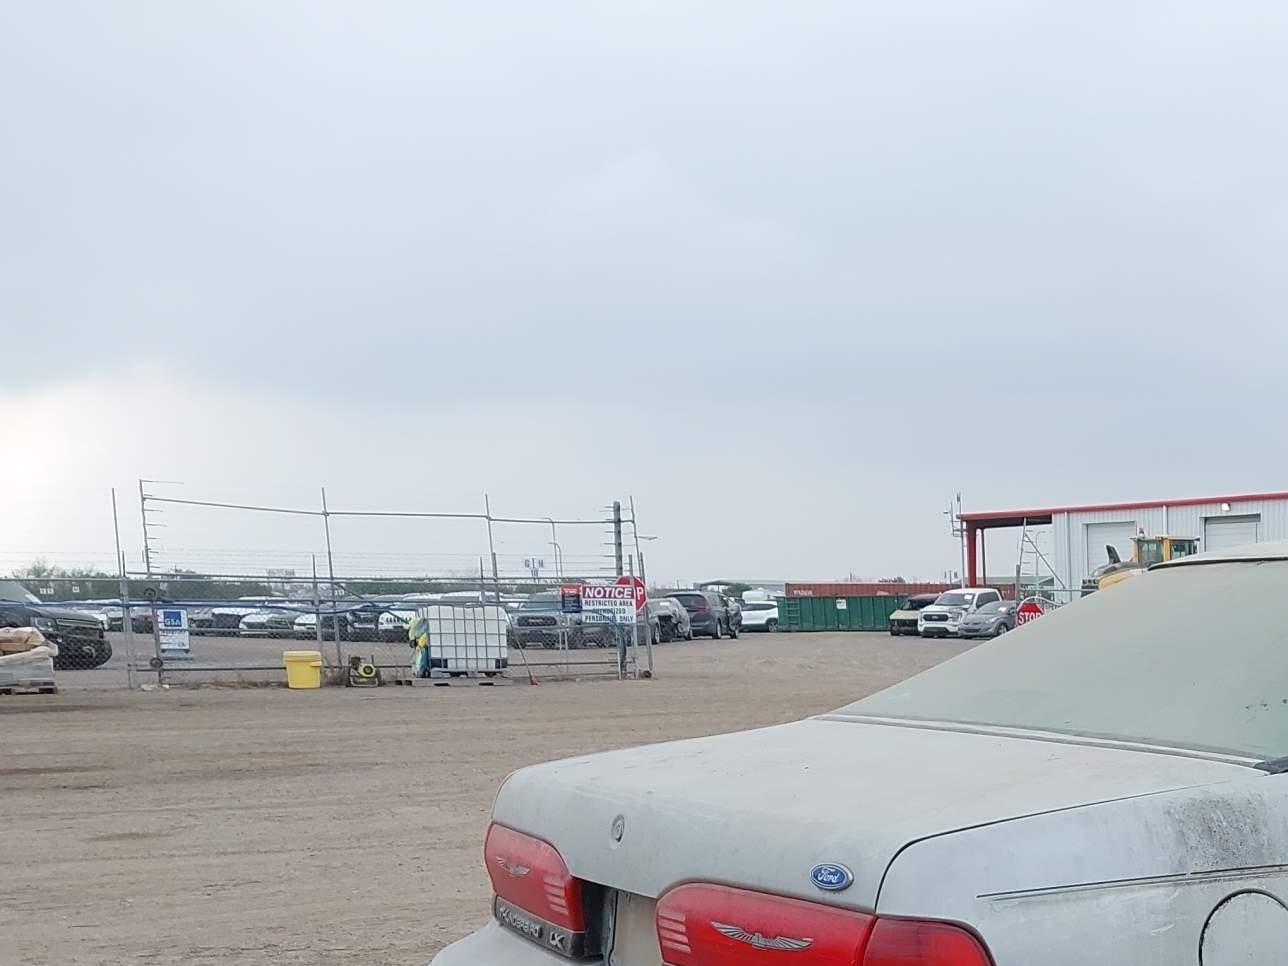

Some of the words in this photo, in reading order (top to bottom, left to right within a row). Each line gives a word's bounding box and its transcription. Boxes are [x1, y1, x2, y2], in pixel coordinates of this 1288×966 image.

[584, 587, 633, 598] NOTICE
[584, 599, 618, 607] RESTRICTED
[619, 615, 634, 623] ONLY
[817, 866, 840, 884] Ford
[549, 931, 566, 952] LX
